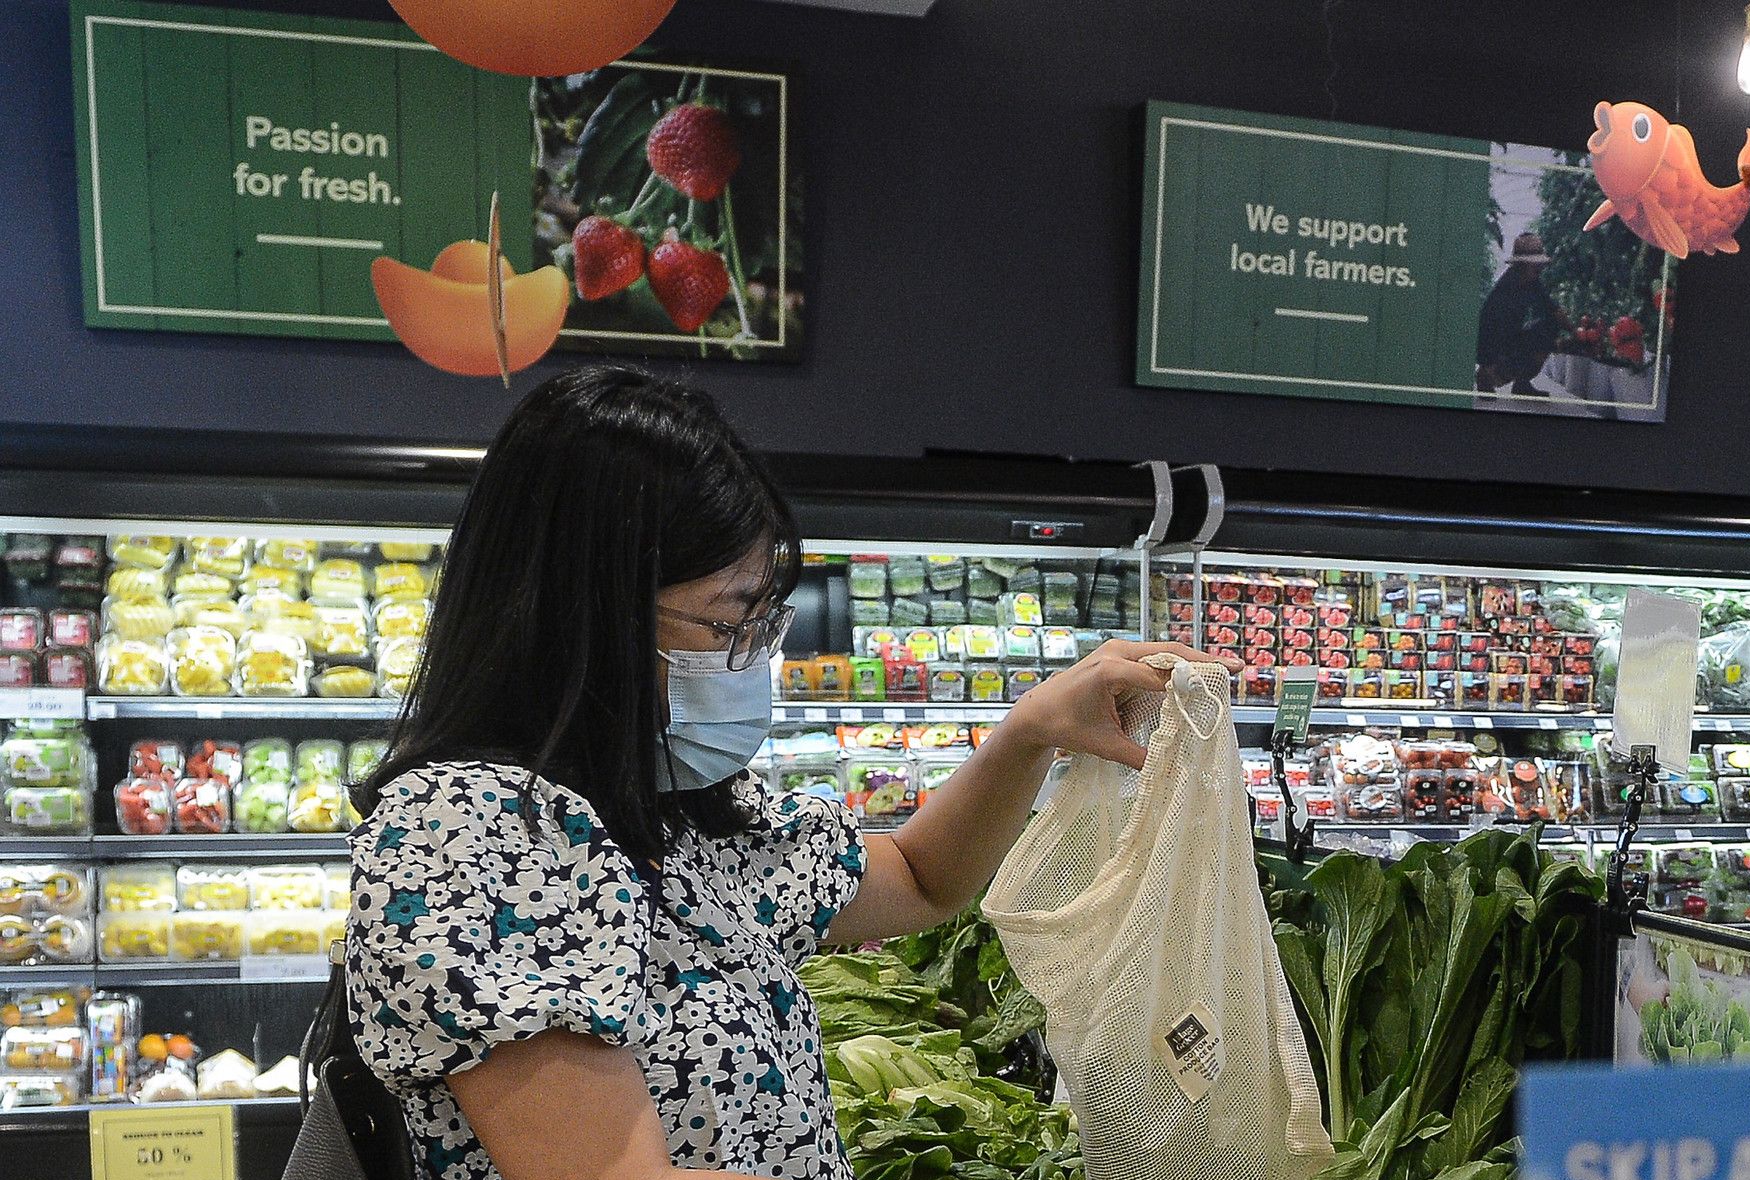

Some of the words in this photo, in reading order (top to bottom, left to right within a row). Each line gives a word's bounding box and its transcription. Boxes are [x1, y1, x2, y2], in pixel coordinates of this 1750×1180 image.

[245, 115, 389, 157] Passion
[234, 162, 286, 199] for
[300, 163, 402, 206] fresh.
[1246, 203, 1290, 236] We
[1297, 214, 1408, 249] support
[1231, 244, 1296, 278] local
[1304, 250, 1416, 290] farmers.
[1183, 1039, 1207, 1062] COTTON
